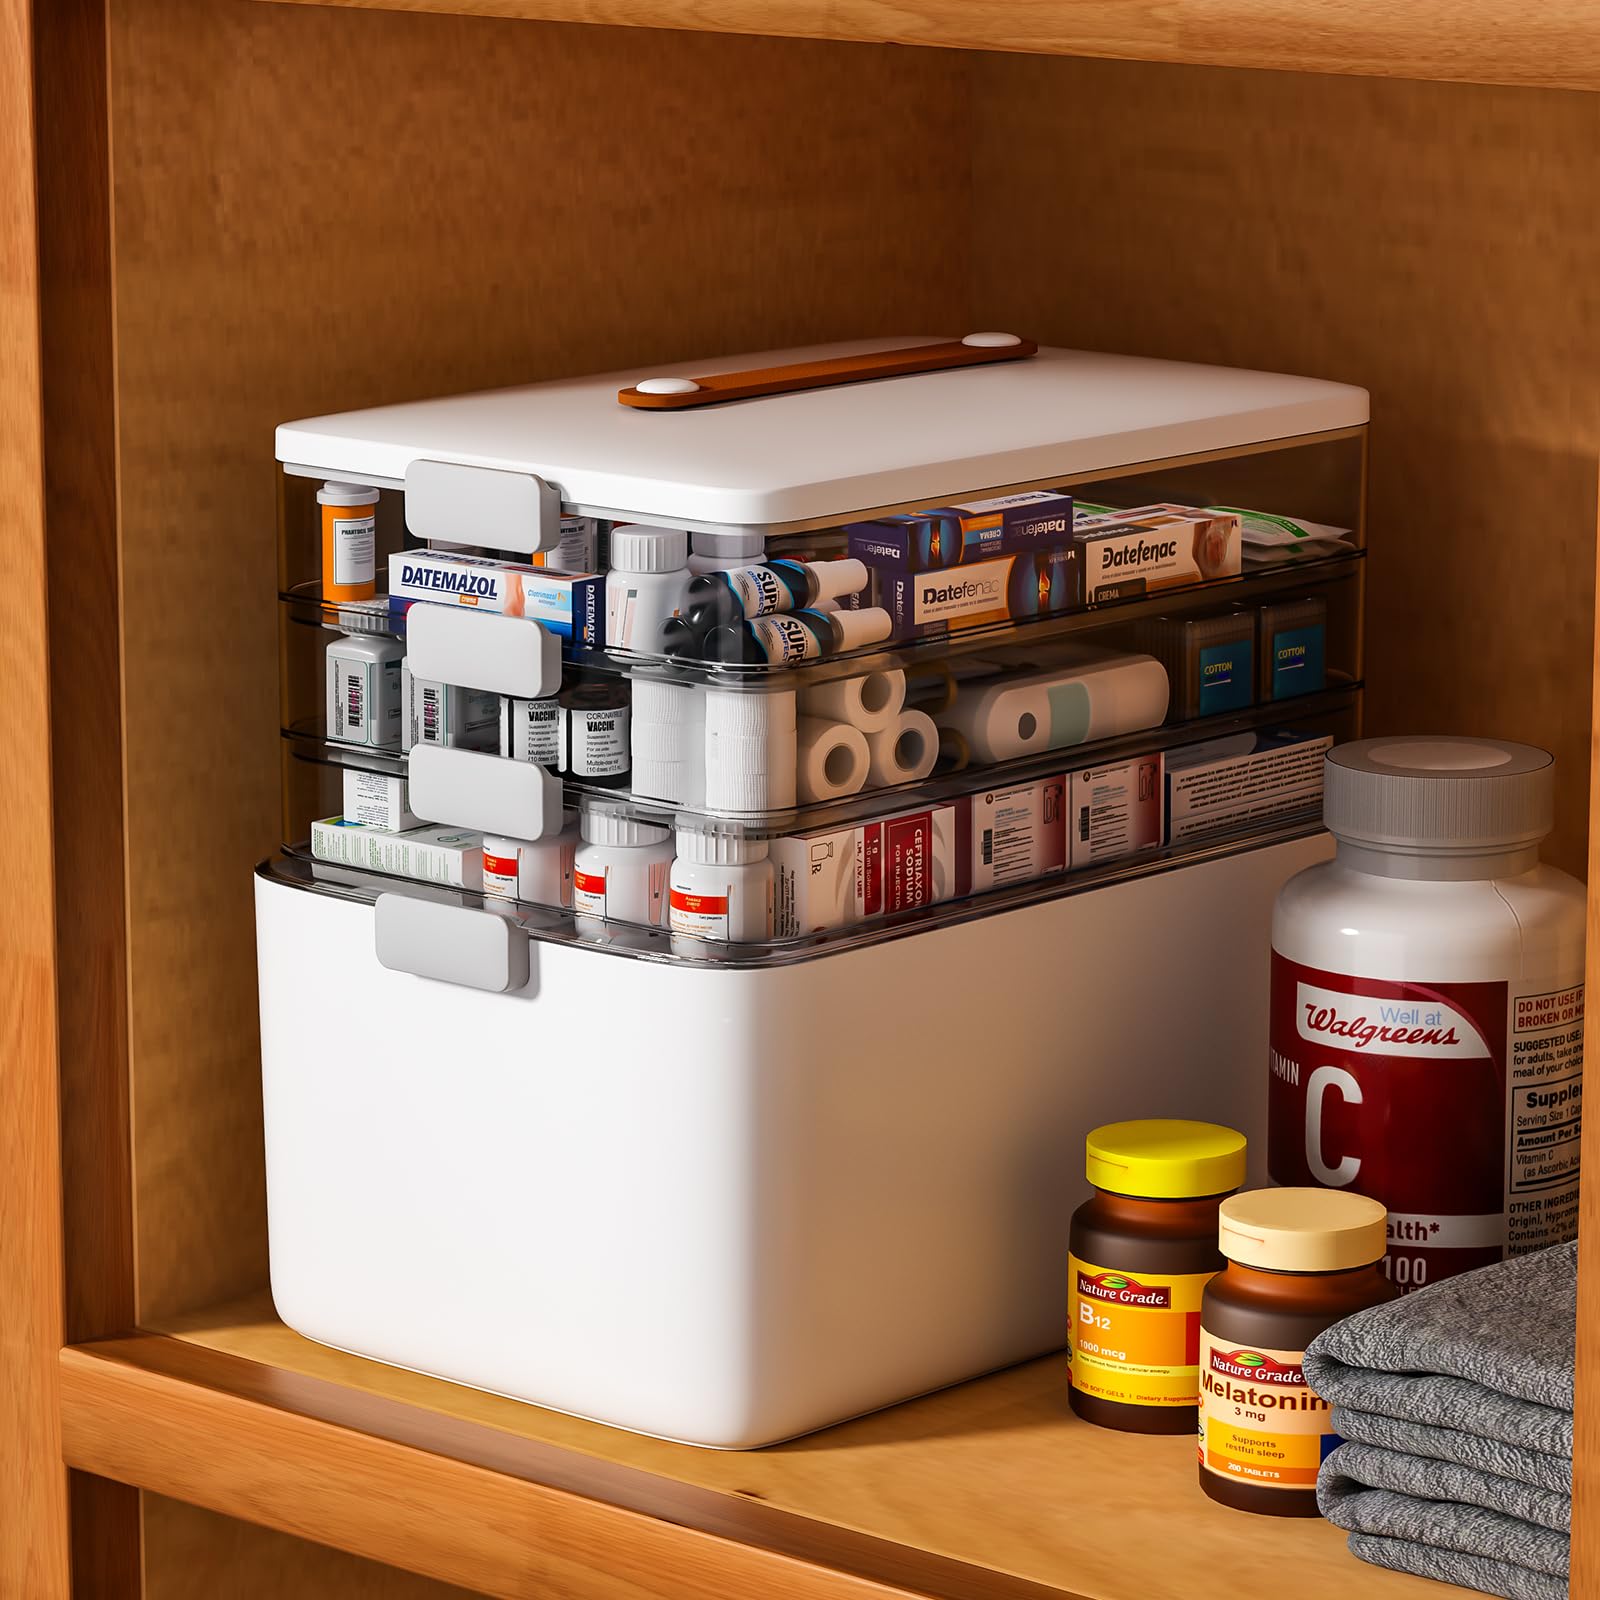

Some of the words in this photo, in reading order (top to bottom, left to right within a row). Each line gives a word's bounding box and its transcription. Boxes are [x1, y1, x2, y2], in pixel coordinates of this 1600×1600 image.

[980, 529, 1002, 540] CREMA
[1102, 540, 1178, 570] Datefenac
[401, 565, 498, 597] DATEMAZOL
[922, 579, 1000, 605] Datefenac
[1278, 646, 1306, 660] COTTON
[1204, 661, 1233, 675] COTTON
[528, 710, 556, 722] VACCINE
[586, 720, 615, 732] VACCINE
[905, 848, 914, 904] SODIUM
[1518, 1001, 1533, 1013] DO
[1535, 997, 1556, 1011] NOT
[1558, 992, 1575, 1007] USE
[1576, 989, 1584, 1001] IF
[1304, 1003, 1461, 1048] Walgreens
[1379, 1005, 1419, 1025] Well
[1424, 1010, 1442, 1026] at
[1518, 1011, 1560, 1028] BROKEN
[1562, 1008, 1574, 1020] OR
[1513, 1034, 1566, 1053] SUGGESTED
[1566, 1029, 1582, 1043] USE:
[1513, 1055, 1526, 1066] for
[1527, 1051, 1555, 1064] adults,
[1557, 1045, 1573, 1058] take
[1513, 1066, 1535, 1078] meal
[1536, 1064, 1545, 1075] of
[1546, 1062, 1564, 1077] your
[1305, 1065, 1363, 1187] C
[1517, 1114, 1547, 1127] Serving
[1549, 1110, 1564, 1122] Size
[1517, 1132, 1556, 1147] Amount
[1558, 1128, 1572, 1140] Per
[1516, 1152, 1546, 1165] Vitamin
[1548, 1149, 1554, 1161] C
[1523, 1167, 1536, 1180] (as
[1537, 1160, 1569, 1176] Ascorbic
[1509, 1200, 1541, 1213] OTHER
[1508, 1228, 1549, 1241] Contains
[1382, 1255, 1427, 1285] 100
[1080, 1278, 1117, 1300] Nature
[1080, 1302, 1111, 1330] B12
[1080, 1339, 1099, 1353] 1000
[1101, 1347, 1126, 1361] mcg
[1212, 1355, 1252, 1377] Nature
[1090, 1385, 1105, 1394] SOFT
[1106, 1389, 1125, 1398] GELS
[1202, 1370, 1328, 1411] Melatonin
[1235, 1406, 1241, 1416] 3
[1245, 1411, 1266, 1422] mg
[1225, 1442, 1254, 1455] restful
[1257, 1449, 1285, 1460] sleep
[1232, 1434, 1276, 1449] Supports
[1228, 1462, 1241, 1472] 200
[1244, 1467, 1280, 1479] TABLETS
